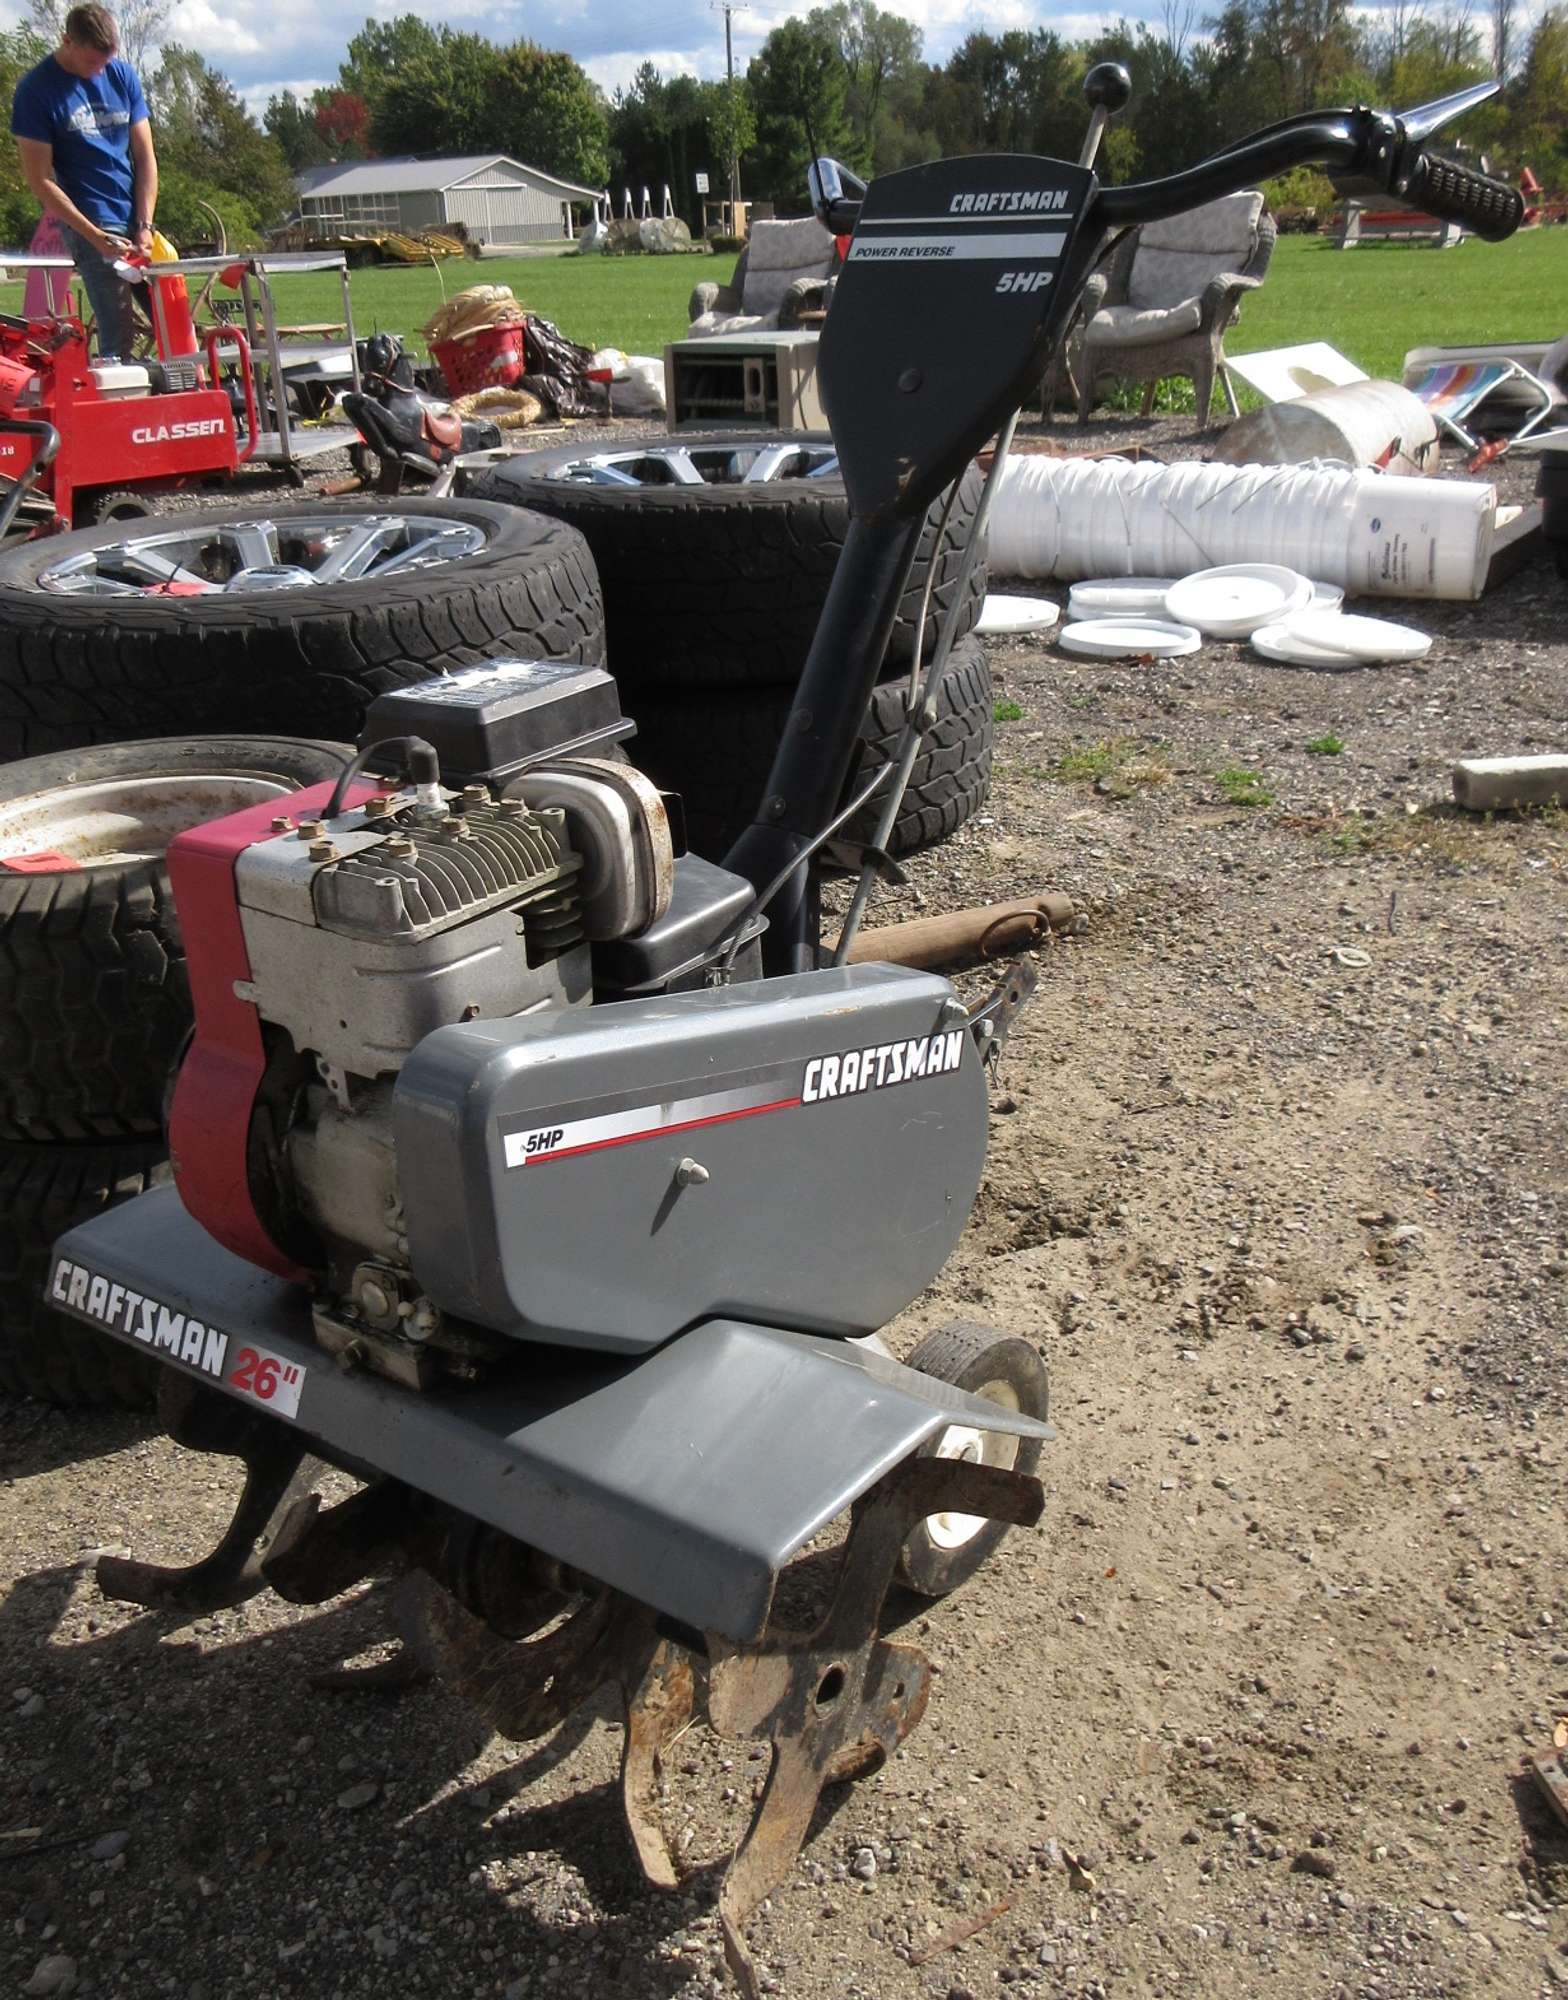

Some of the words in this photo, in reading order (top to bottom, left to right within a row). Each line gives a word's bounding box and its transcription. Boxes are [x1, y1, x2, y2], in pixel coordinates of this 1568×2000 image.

[950, 190, 1068, 213] CRAFTSMAN
[855, 247, 898, 258] POWER
[900, 246, 955, 257] REVERSE
[995, 272, 1054, 293] 5HP
[131, 418, 226, 444] CLASSEN
[802, 1030, 964, 1103] CRAFTSMAN
[526, 1129, 564, 1153] 5HP
[52, 1259, 229, 1377] CRAFTSMAN
[229, 1347, 299, 1400] 26"
